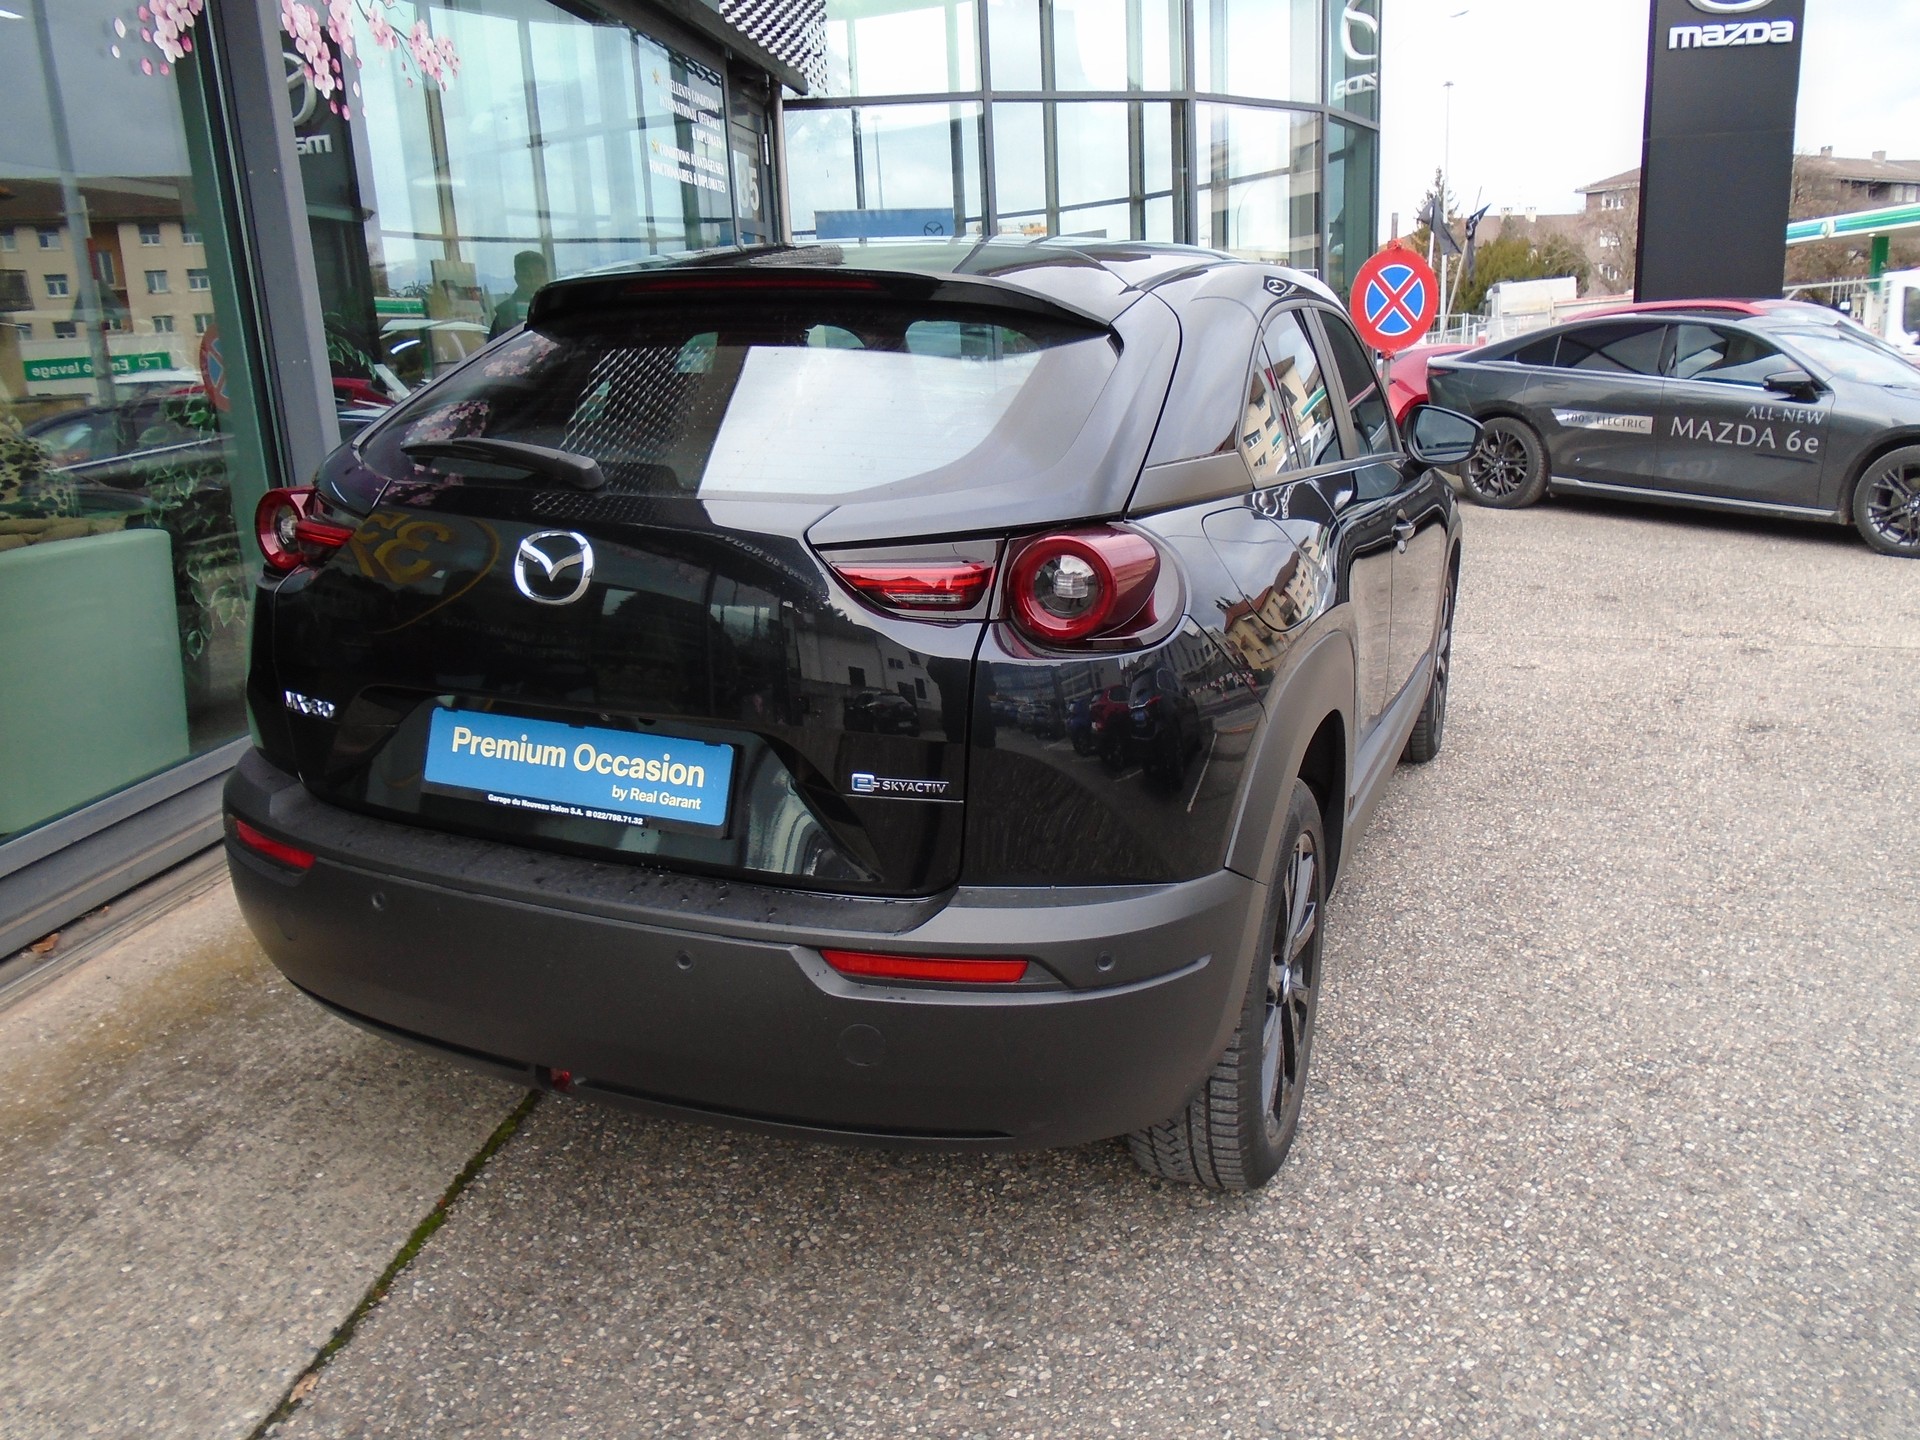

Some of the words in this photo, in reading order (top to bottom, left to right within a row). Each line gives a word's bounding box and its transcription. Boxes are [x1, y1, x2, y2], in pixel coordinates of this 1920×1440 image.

[661, 77, 692, 101] ELLENTS
[691, 89, 719, 113] CONDITIONS
[659, 95, 698, 122] INTERNATIONAL
[697, 128, 722, 148] DIPLOMATS
[698, 174, 726, 193] DIPLOMATES
[1595, 415, 1647, 430] ELECTRIC
[1745, 405, 1825, 426] ALL-NEW
[1670, 415, 1776, 449] MAZDA
[1786, 429, 1820, 454] 6e
[451, 726, 567, 768] Premium
[573, 743, 705, 788] Occasion
[487, 793, 511, 805] Garage
[512, 798, 521, 806] du
[521, 799, 550, 811] Nouveau
[550, 804, 570, 814] Salon
[570, 807, 583, 816] S.A.
[611, 785, 628, 801] by
[630, 787, 657, 804] Real
[659, 792, 702, 810] Garant
